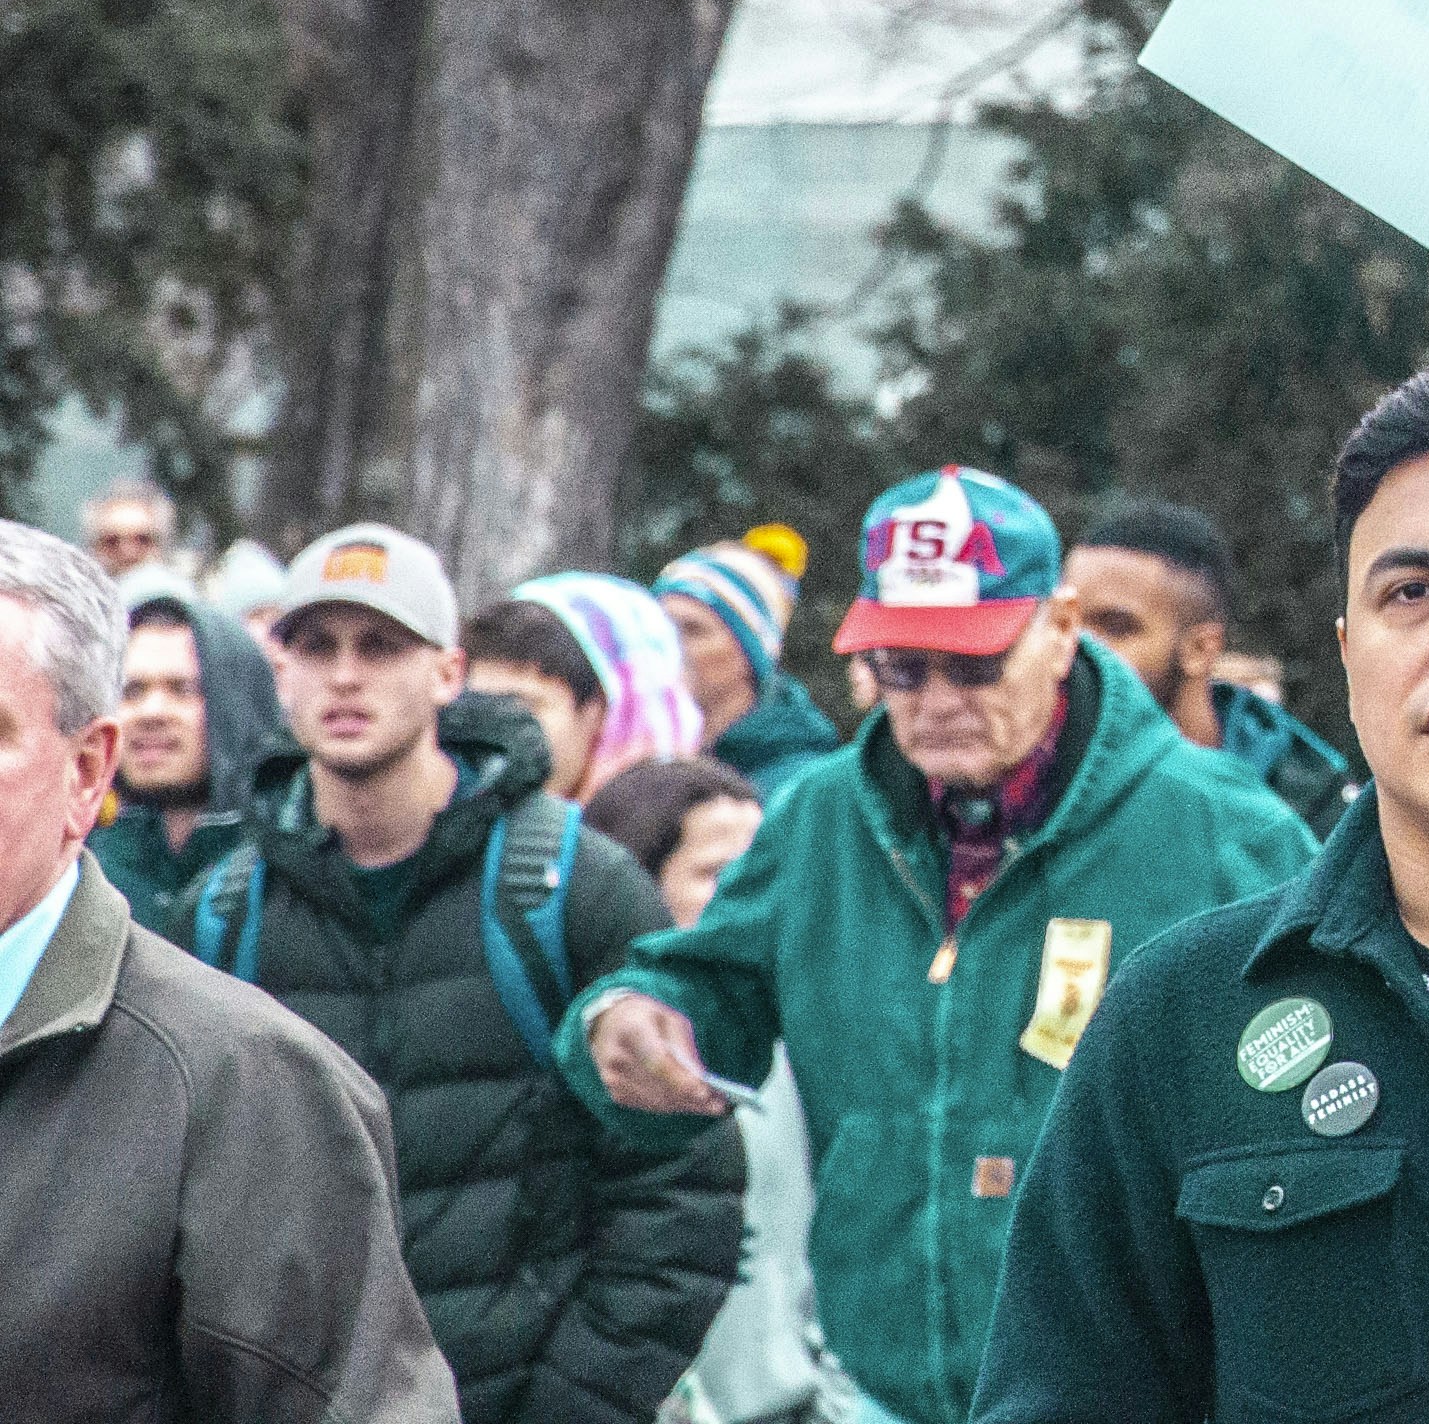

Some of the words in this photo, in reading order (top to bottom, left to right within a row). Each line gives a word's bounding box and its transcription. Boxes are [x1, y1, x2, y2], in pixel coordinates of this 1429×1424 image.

[1248, 1018, 1315, 1074] EQUALITY
[1257, 1053, 1289, 1080] FOR
[1308, 1082, 1376, 1125] FEMINIST
[1309, 1075, 1366, 1110] BADASS
